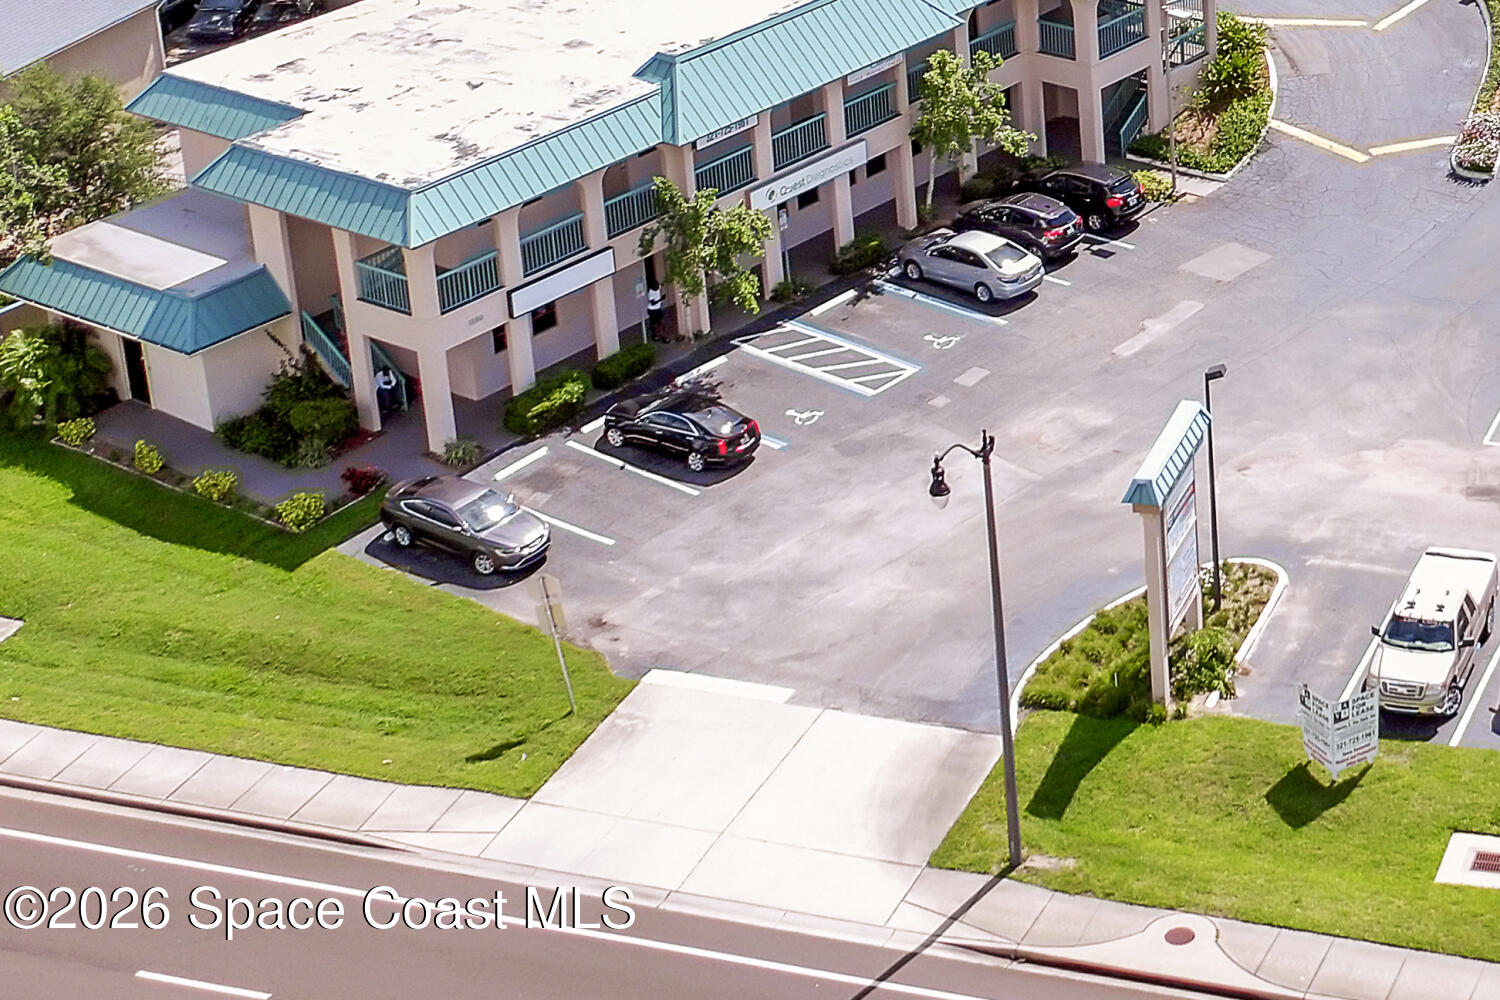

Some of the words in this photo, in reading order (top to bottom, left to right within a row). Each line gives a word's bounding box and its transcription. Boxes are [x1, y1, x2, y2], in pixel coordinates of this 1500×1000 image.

[780, 178, 806, 196] Quest
[1352, 691, 1375, 704] SPACE
[1352, 701, 1366, 710] FOR
[1352, 705, 1374, 718] LEASE
